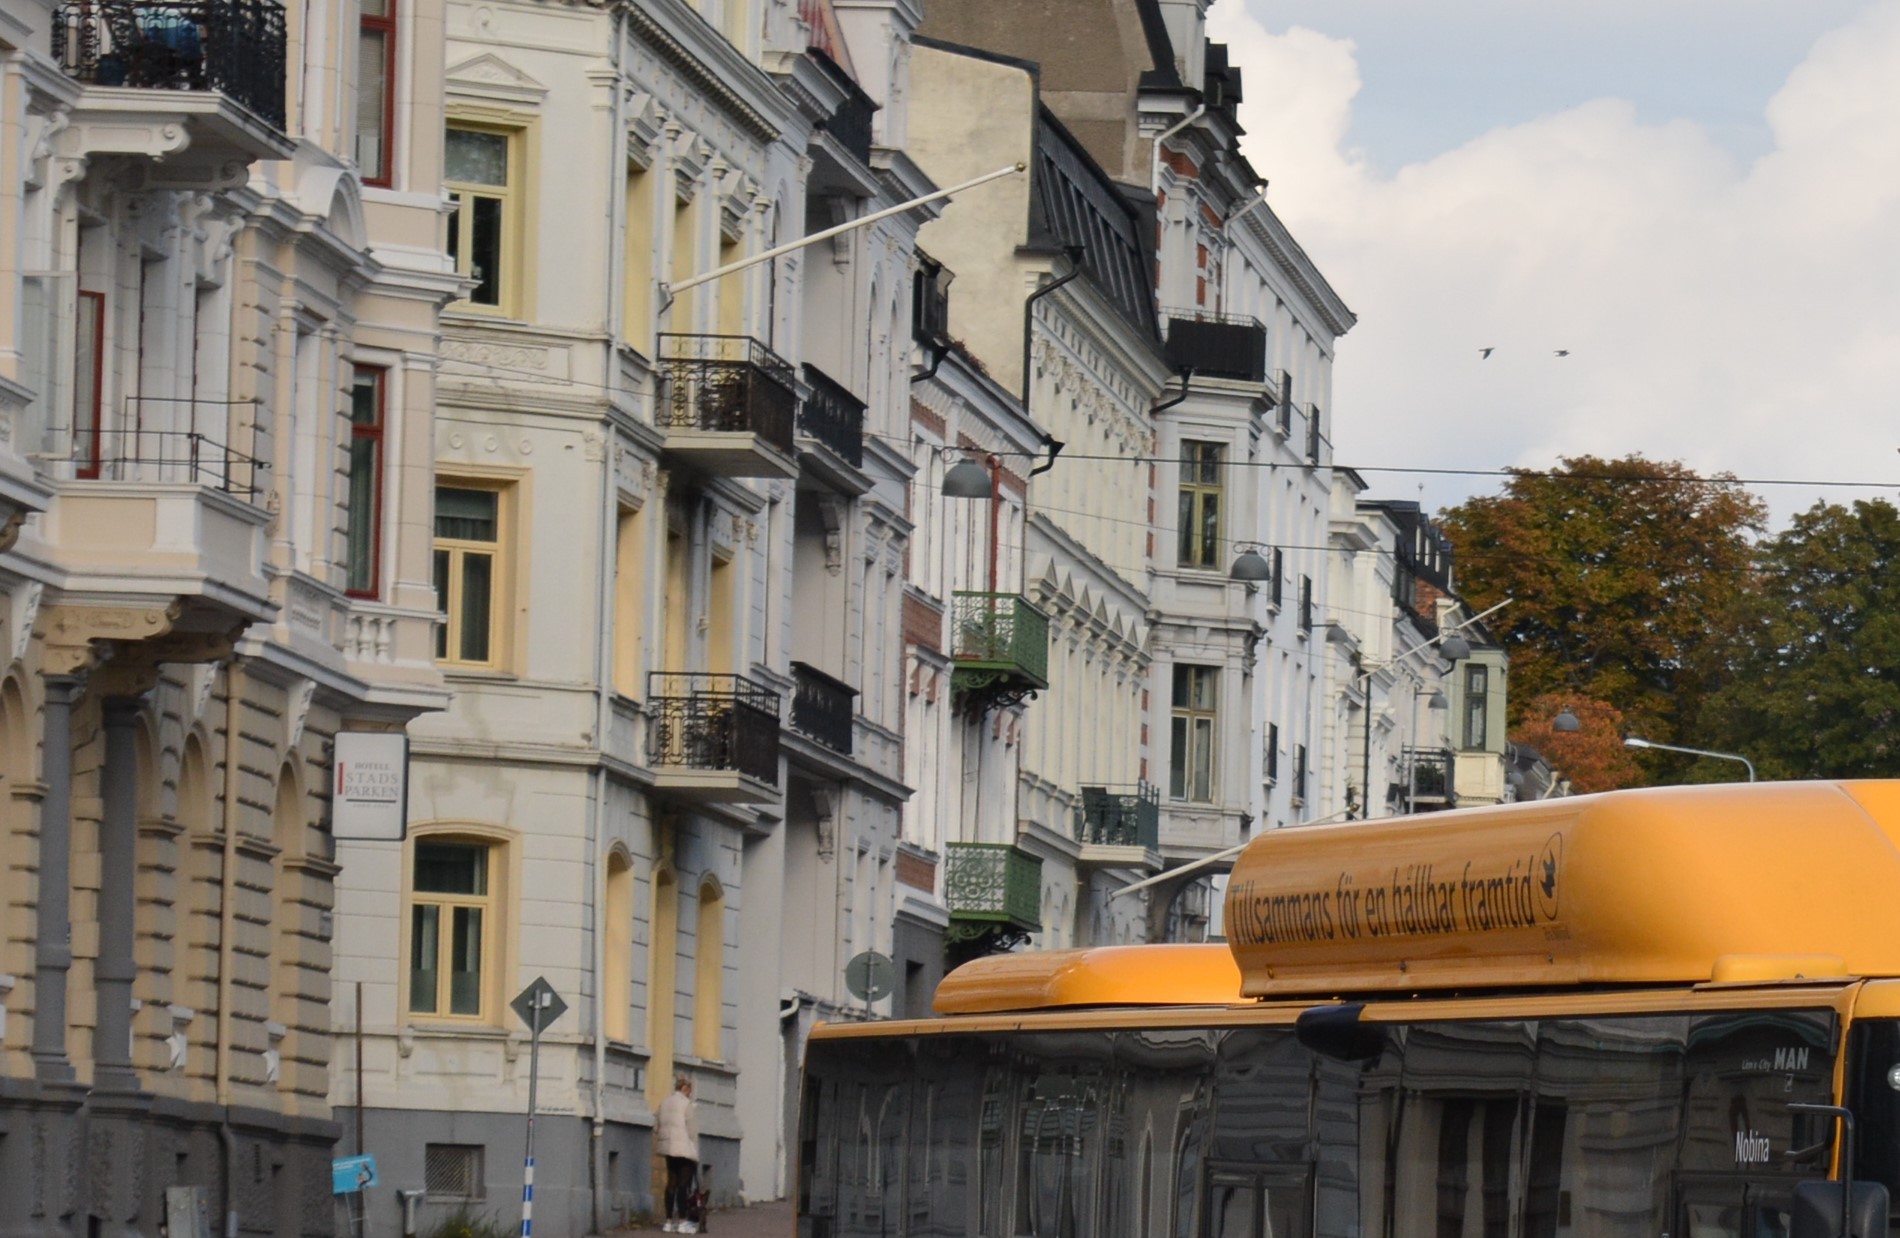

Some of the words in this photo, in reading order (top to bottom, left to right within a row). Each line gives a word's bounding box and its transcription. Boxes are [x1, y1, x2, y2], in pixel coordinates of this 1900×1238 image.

[346, 772, 398, 784] STADS
[345, 786, 399, 797] PARKEN
[1231, 879, 1334, 945] Tillsammans
[1336, 871, 1361, 938] för
[1365, 887, 1390, 937] en
[1392, 863, 1458, 936] hållbar
[1460, 854, 1536, 932] framtid
[1774, 1047, 1809, 1070] MAN
[1735, 1129, 1769, 1163] Nobina
